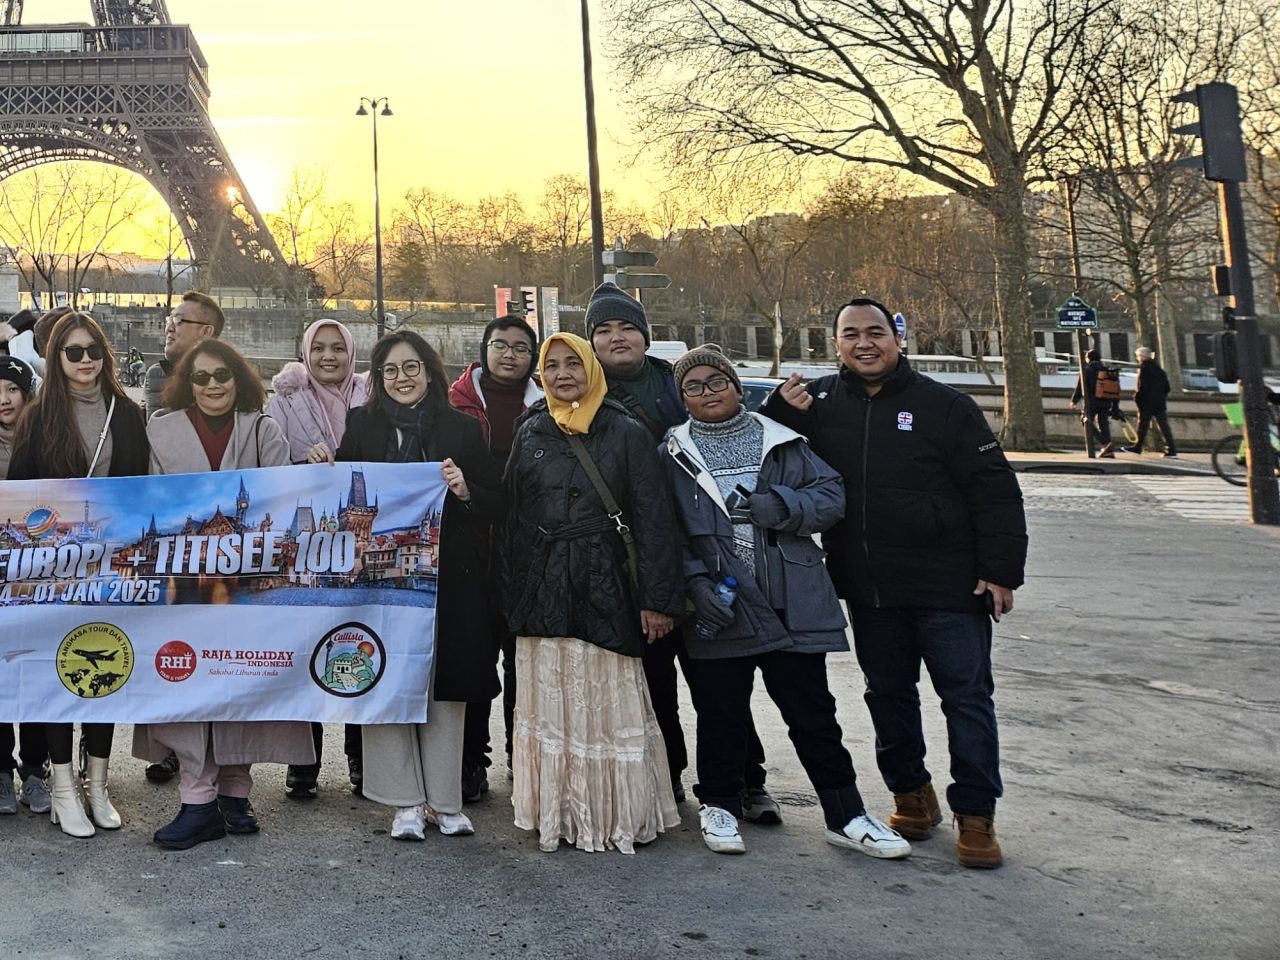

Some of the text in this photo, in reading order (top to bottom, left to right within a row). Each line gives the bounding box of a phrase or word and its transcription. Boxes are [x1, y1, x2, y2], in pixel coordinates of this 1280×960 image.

[128, 550, 146, 567] +
[155, 531, 284, 574] TITISEE
[33, 584, 56, 603] 01
[60, 581, 103, 603] JAN
[108, 579, 161, 603] 2025
[333, 632, 364, 641] Callista
[62, 629, 87, 657] ANGKASA
[109, 630, 122, 642] DAN
[120, 642, 130, 668] TRAVEL
[202, 649, 294, 661] RAJA HOLIDAY
[160, 655, 192, 669] RHI
[248, 660, 294, 668] INDONESIA
